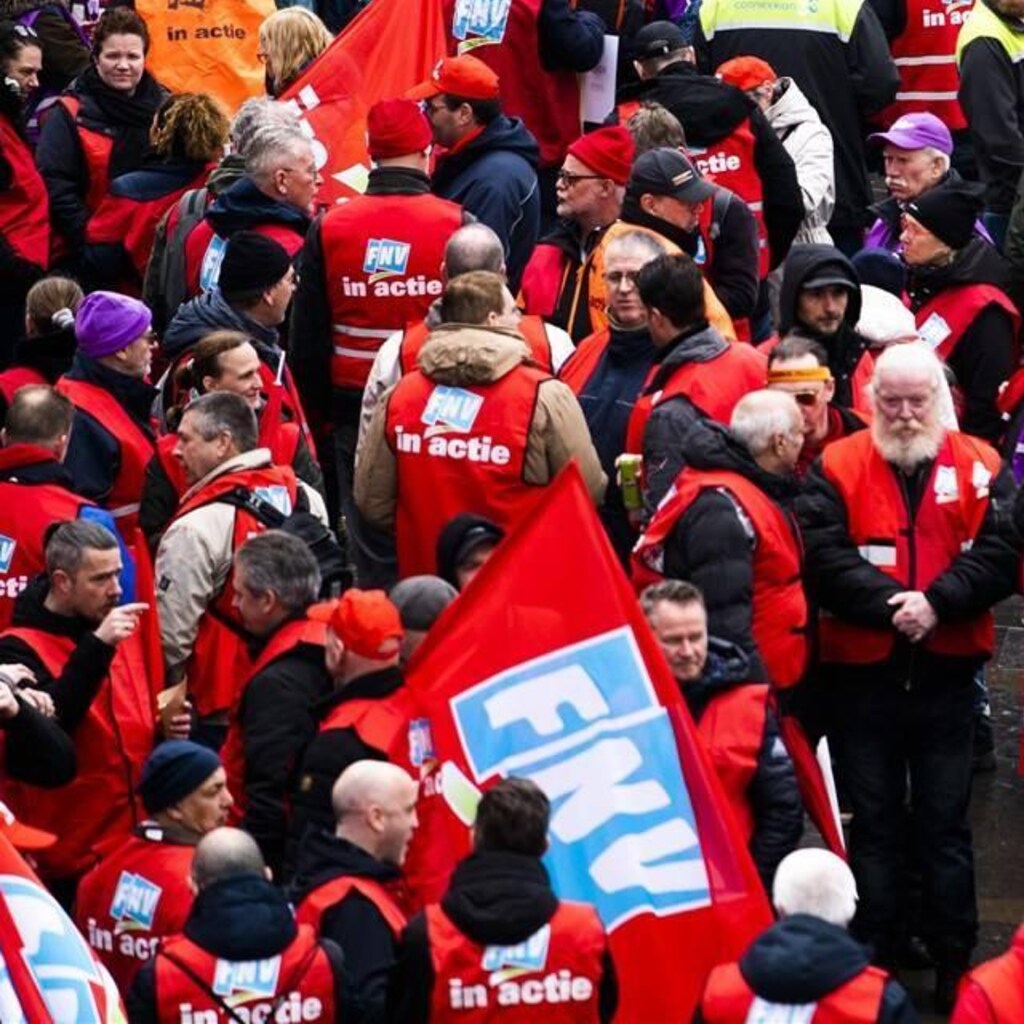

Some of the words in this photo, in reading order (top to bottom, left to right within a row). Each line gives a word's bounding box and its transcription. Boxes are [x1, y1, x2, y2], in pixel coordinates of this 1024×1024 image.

[923, 8, 945, 27] in
[167, 25, 187, 41] in
[194, 23, 246, 40] actie
[697, 154, 741, 174] ctie
[366, 247, 408, 269] FNV
[342, 277, 367, 298] in
[374, 275, 443, 297] actie
[428, 393, 480, 429] FNV
[396, 424, 421, 452] in
[428, 435, 511, 465] actie
[483, 663, 712, 895] FNV
[88, 918, 113, 952] in
[449, 980, 488, 1008] in
[497, 970, 593, 1006] actie
